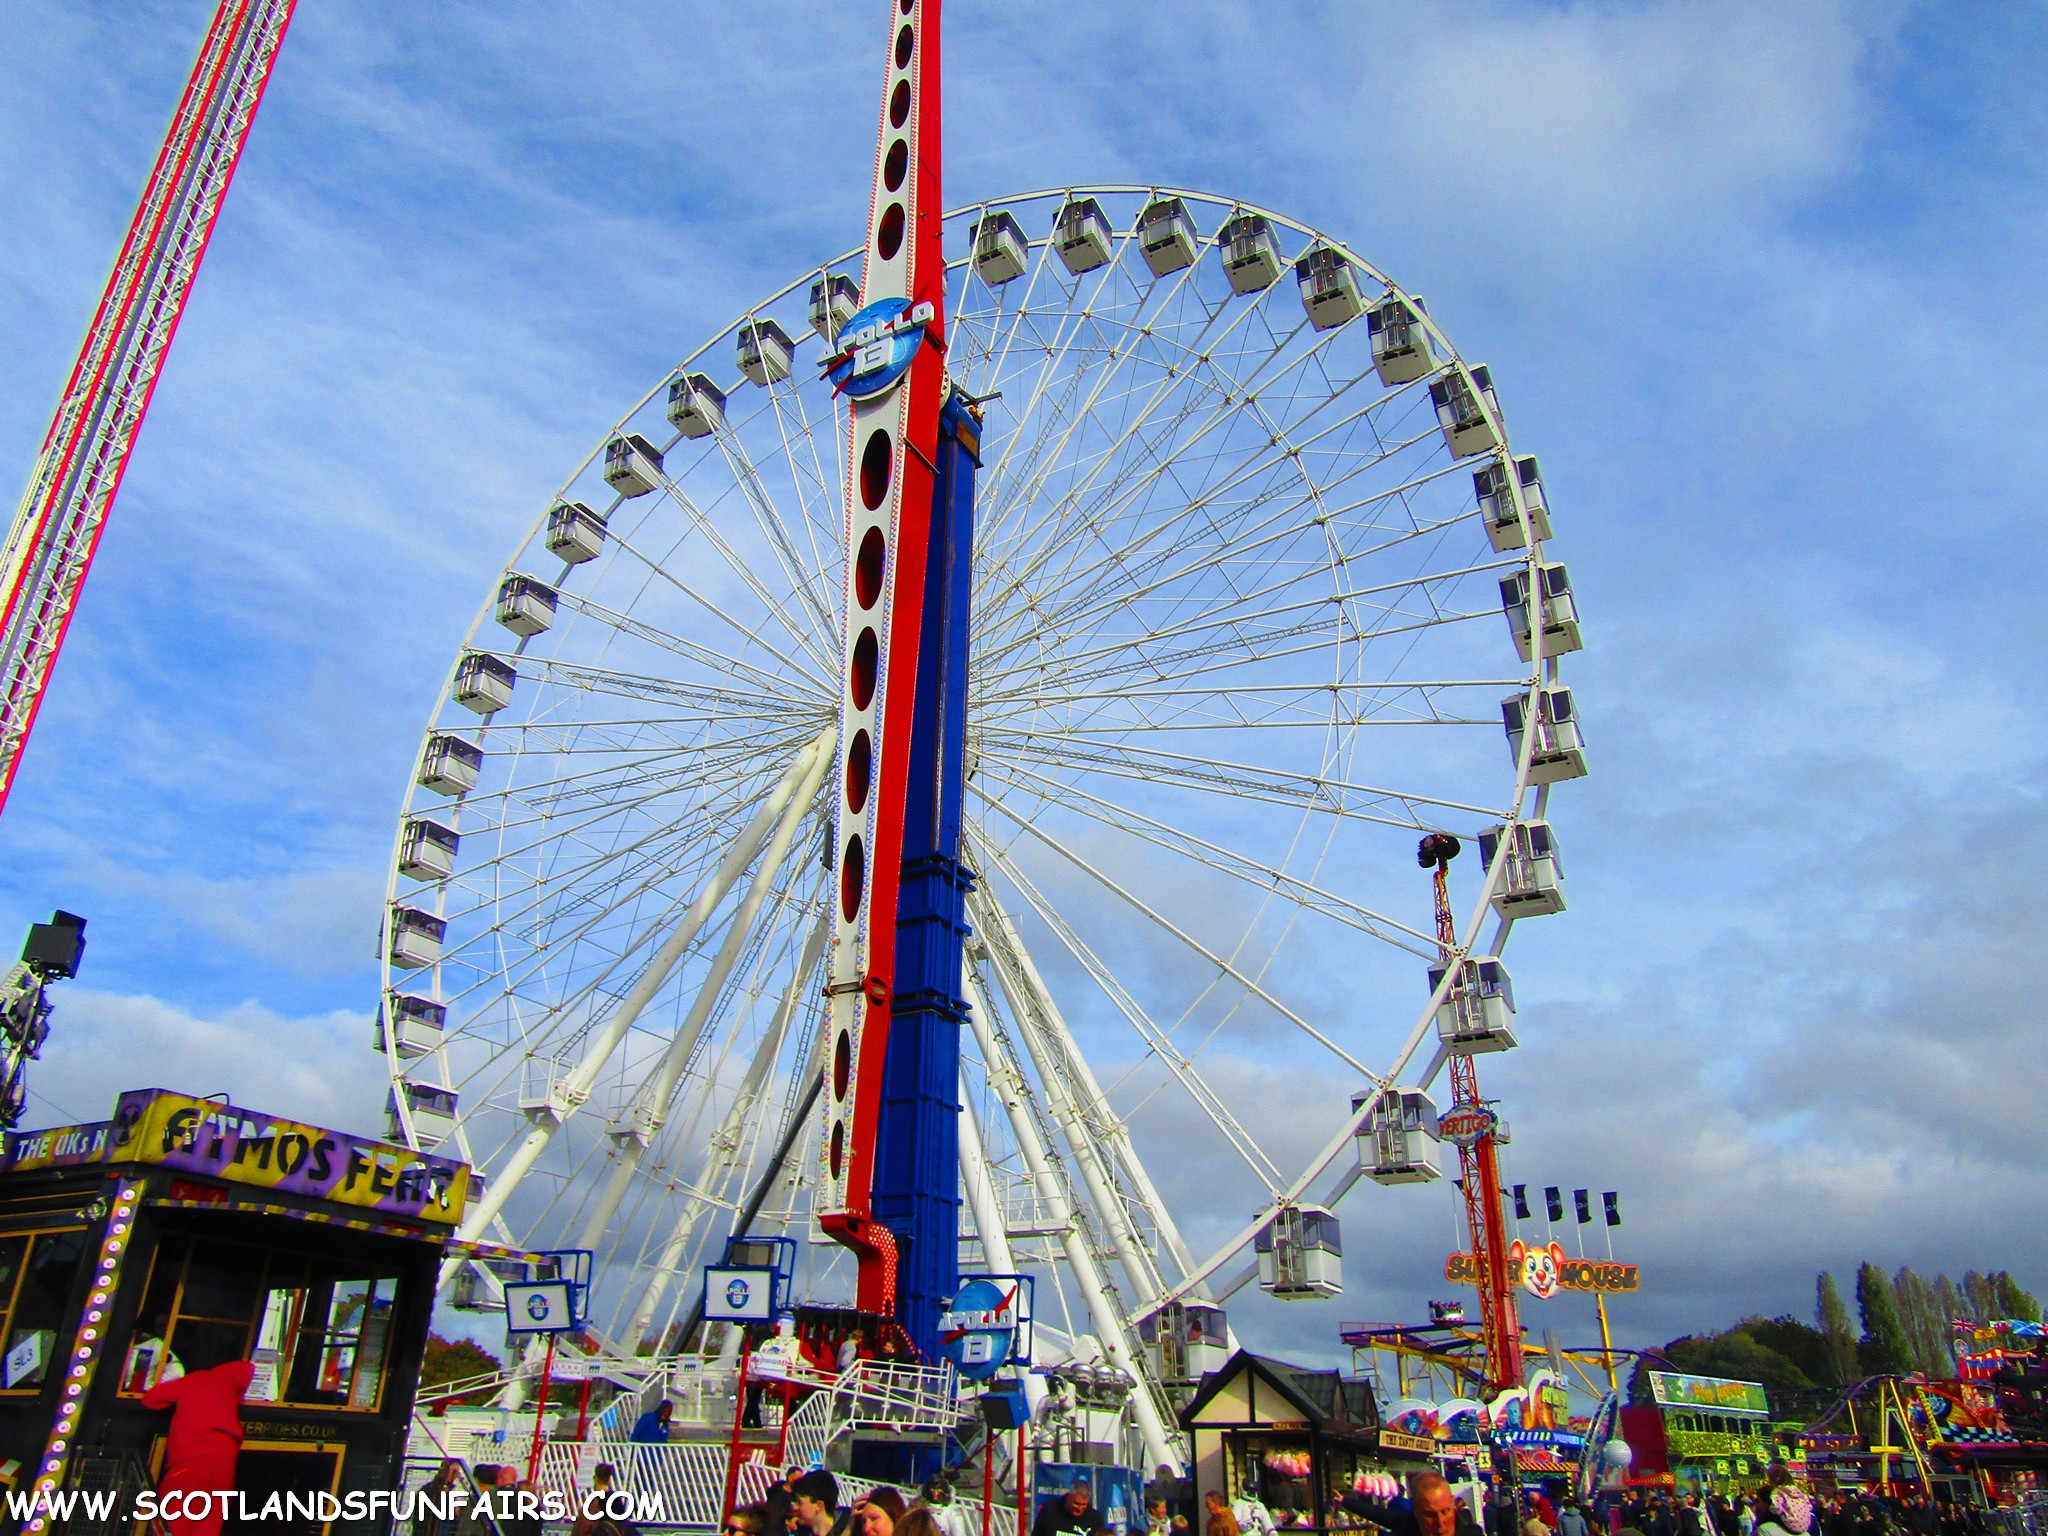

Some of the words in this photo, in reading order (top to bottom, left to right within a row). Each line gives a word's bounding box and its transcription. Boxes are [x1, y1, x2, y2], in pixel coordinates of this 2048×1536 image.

[816, 301, 934, 366] APOLLO
[853, 336, 894, 377] 13
[1439, 1113, 1491, 1135] VERTIGO
[17, 1137, 49, 1161] THE
[163, 1108, 335, 1182] ATMOS
[345, 1147, 456, 1211] FEAR
[1559, 1262, 1637, 1290] MOUSE
[937, 1310, 1016, 1331] APOLLO
[962, 1334, 992, 1363] 13
[1386, 1433, 1397, 1446] THE
[1399, 1434, 1415, 1448] TASTY
[1416, 1438, 1430, 1450] GRILL
